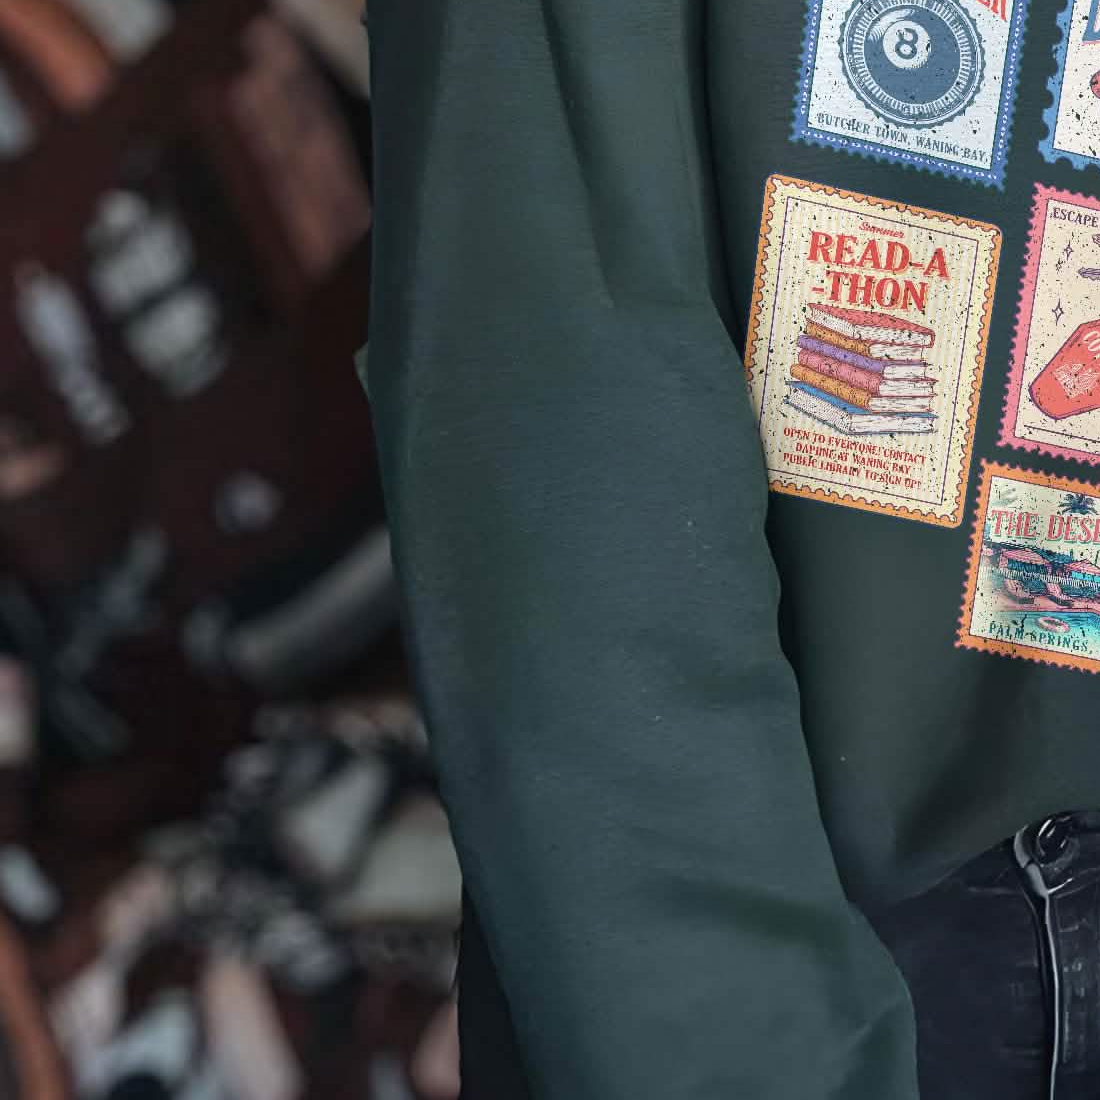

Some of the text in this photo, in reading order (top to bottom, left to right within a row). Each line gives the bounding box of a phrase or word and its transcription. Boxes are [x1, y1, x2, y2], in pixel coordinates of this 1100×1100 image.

[895, 27, 918, 60] 8
[817, 113, 870, 135] BUTCHER
[916, 136, 959, 156] WANING
[1053, 207, 1099, 228] ESCAPE
[806, 230, 949, 281] READ-A
[783, 427, 810, 440] OPEN
[813, 432, 825, 444] TO
[883, 448, 926, 465] CONTACT
[991, 509, 1040, 539] THE
[989, 621, 1024, 640] PALM
